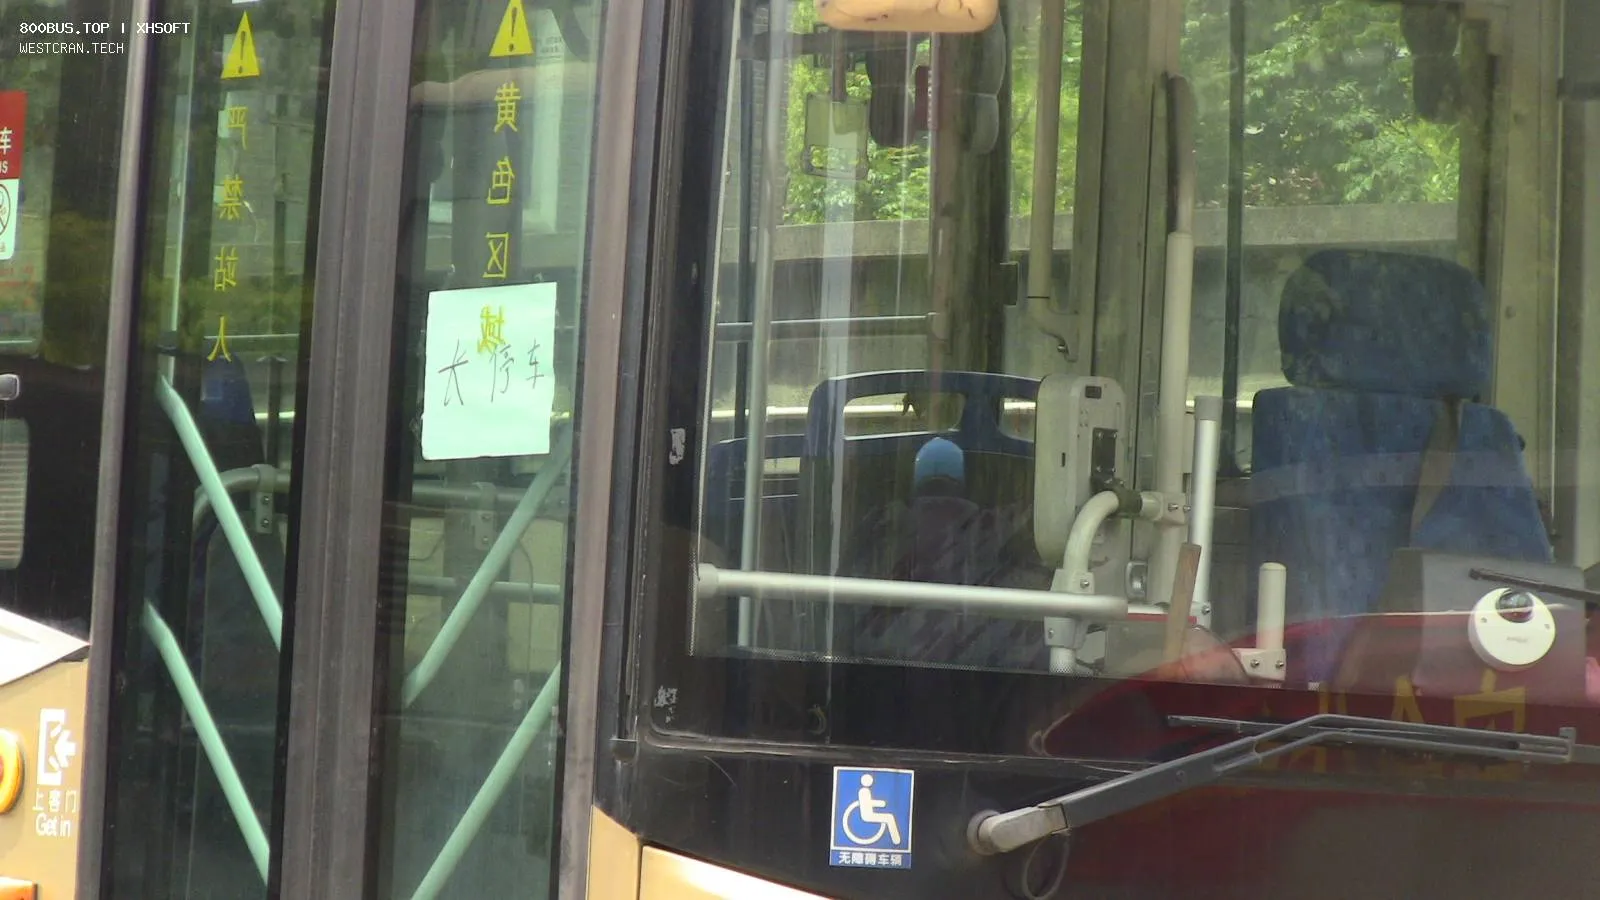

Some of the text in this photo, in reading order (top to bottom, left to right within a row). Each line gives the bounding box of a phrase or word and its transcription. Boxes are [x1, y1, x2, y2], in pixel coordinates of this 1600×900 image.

[36, 812, 71, 837] Get in
[838, 851, 903, 867] 无障碍车辆
